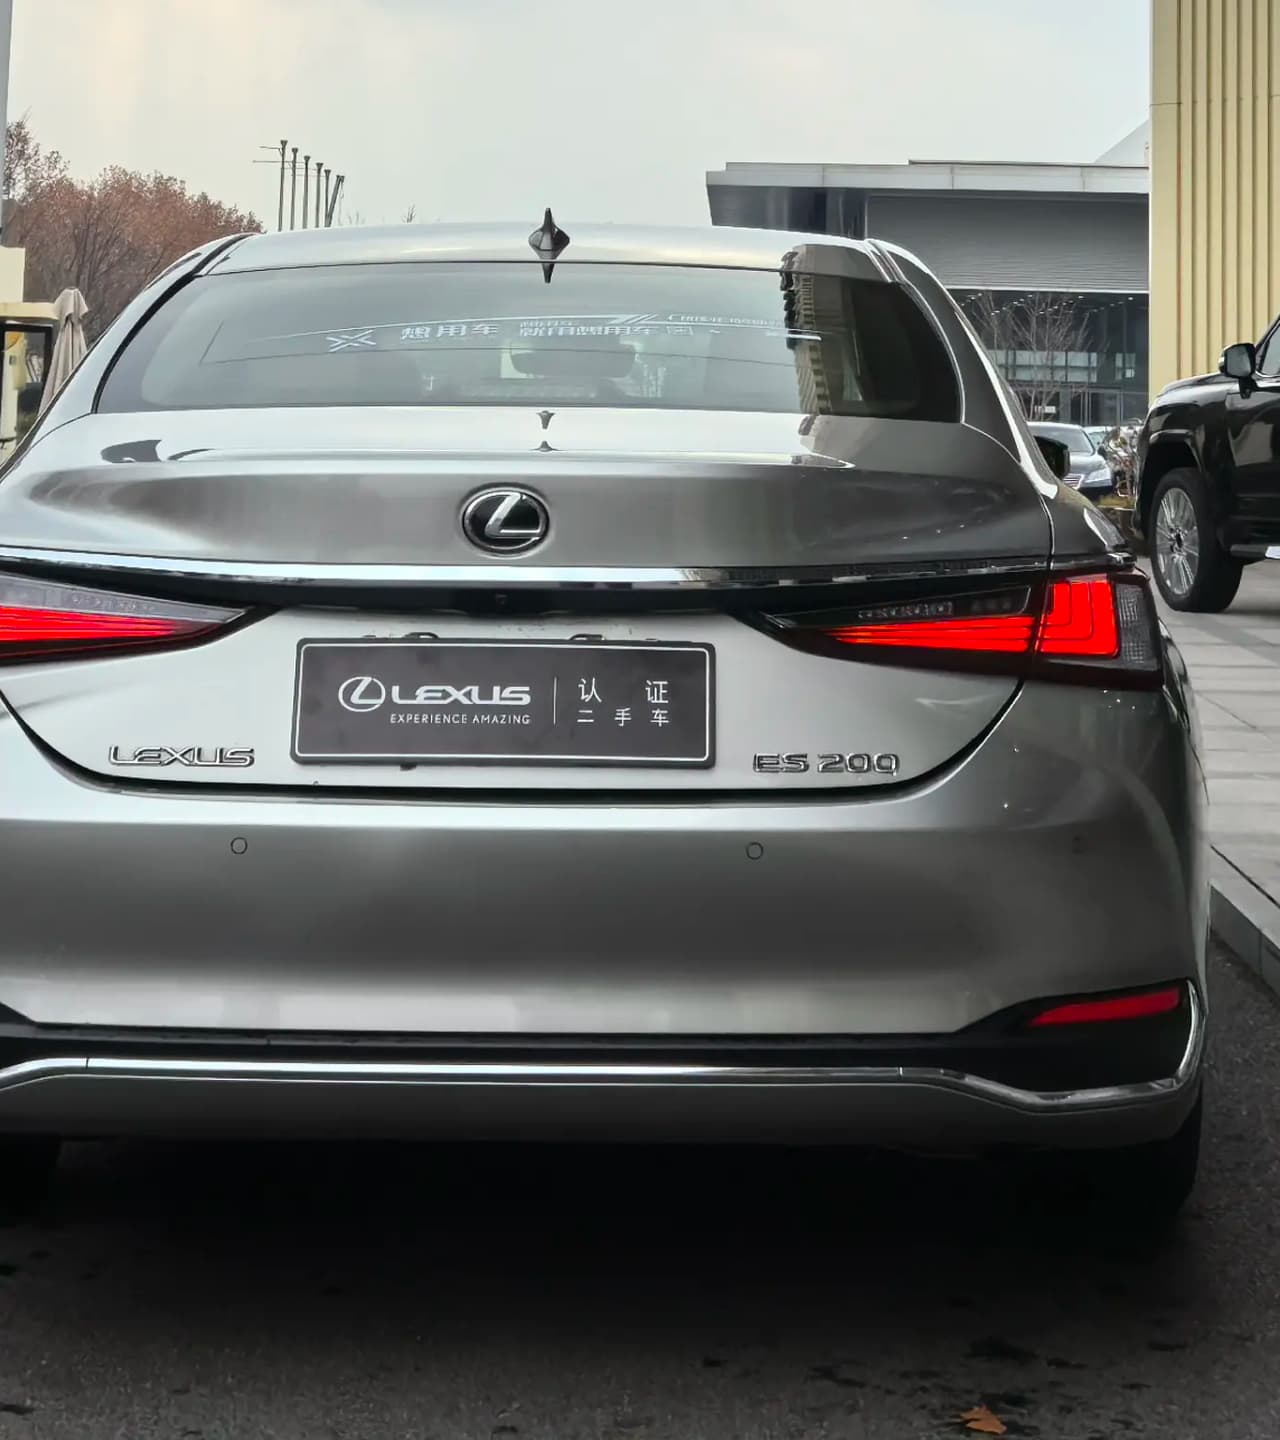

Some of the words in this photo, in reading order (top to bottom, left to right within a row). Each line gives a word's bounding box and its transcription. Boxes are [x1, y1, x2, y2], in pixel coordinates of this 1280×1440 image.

[391, 684, 531, 705] LEXUS
[577, 678, 669, 704] 认证
[390, 714, 468, 725] EXPERIENCE
[472, 715, 531, 725] AMAZING
[577, 707, 669, 728] 二手车
[109, 745, 255, 768] LEXUS
[753, 753, 809, 774] ES
[818, 753, 900, 774] 200
